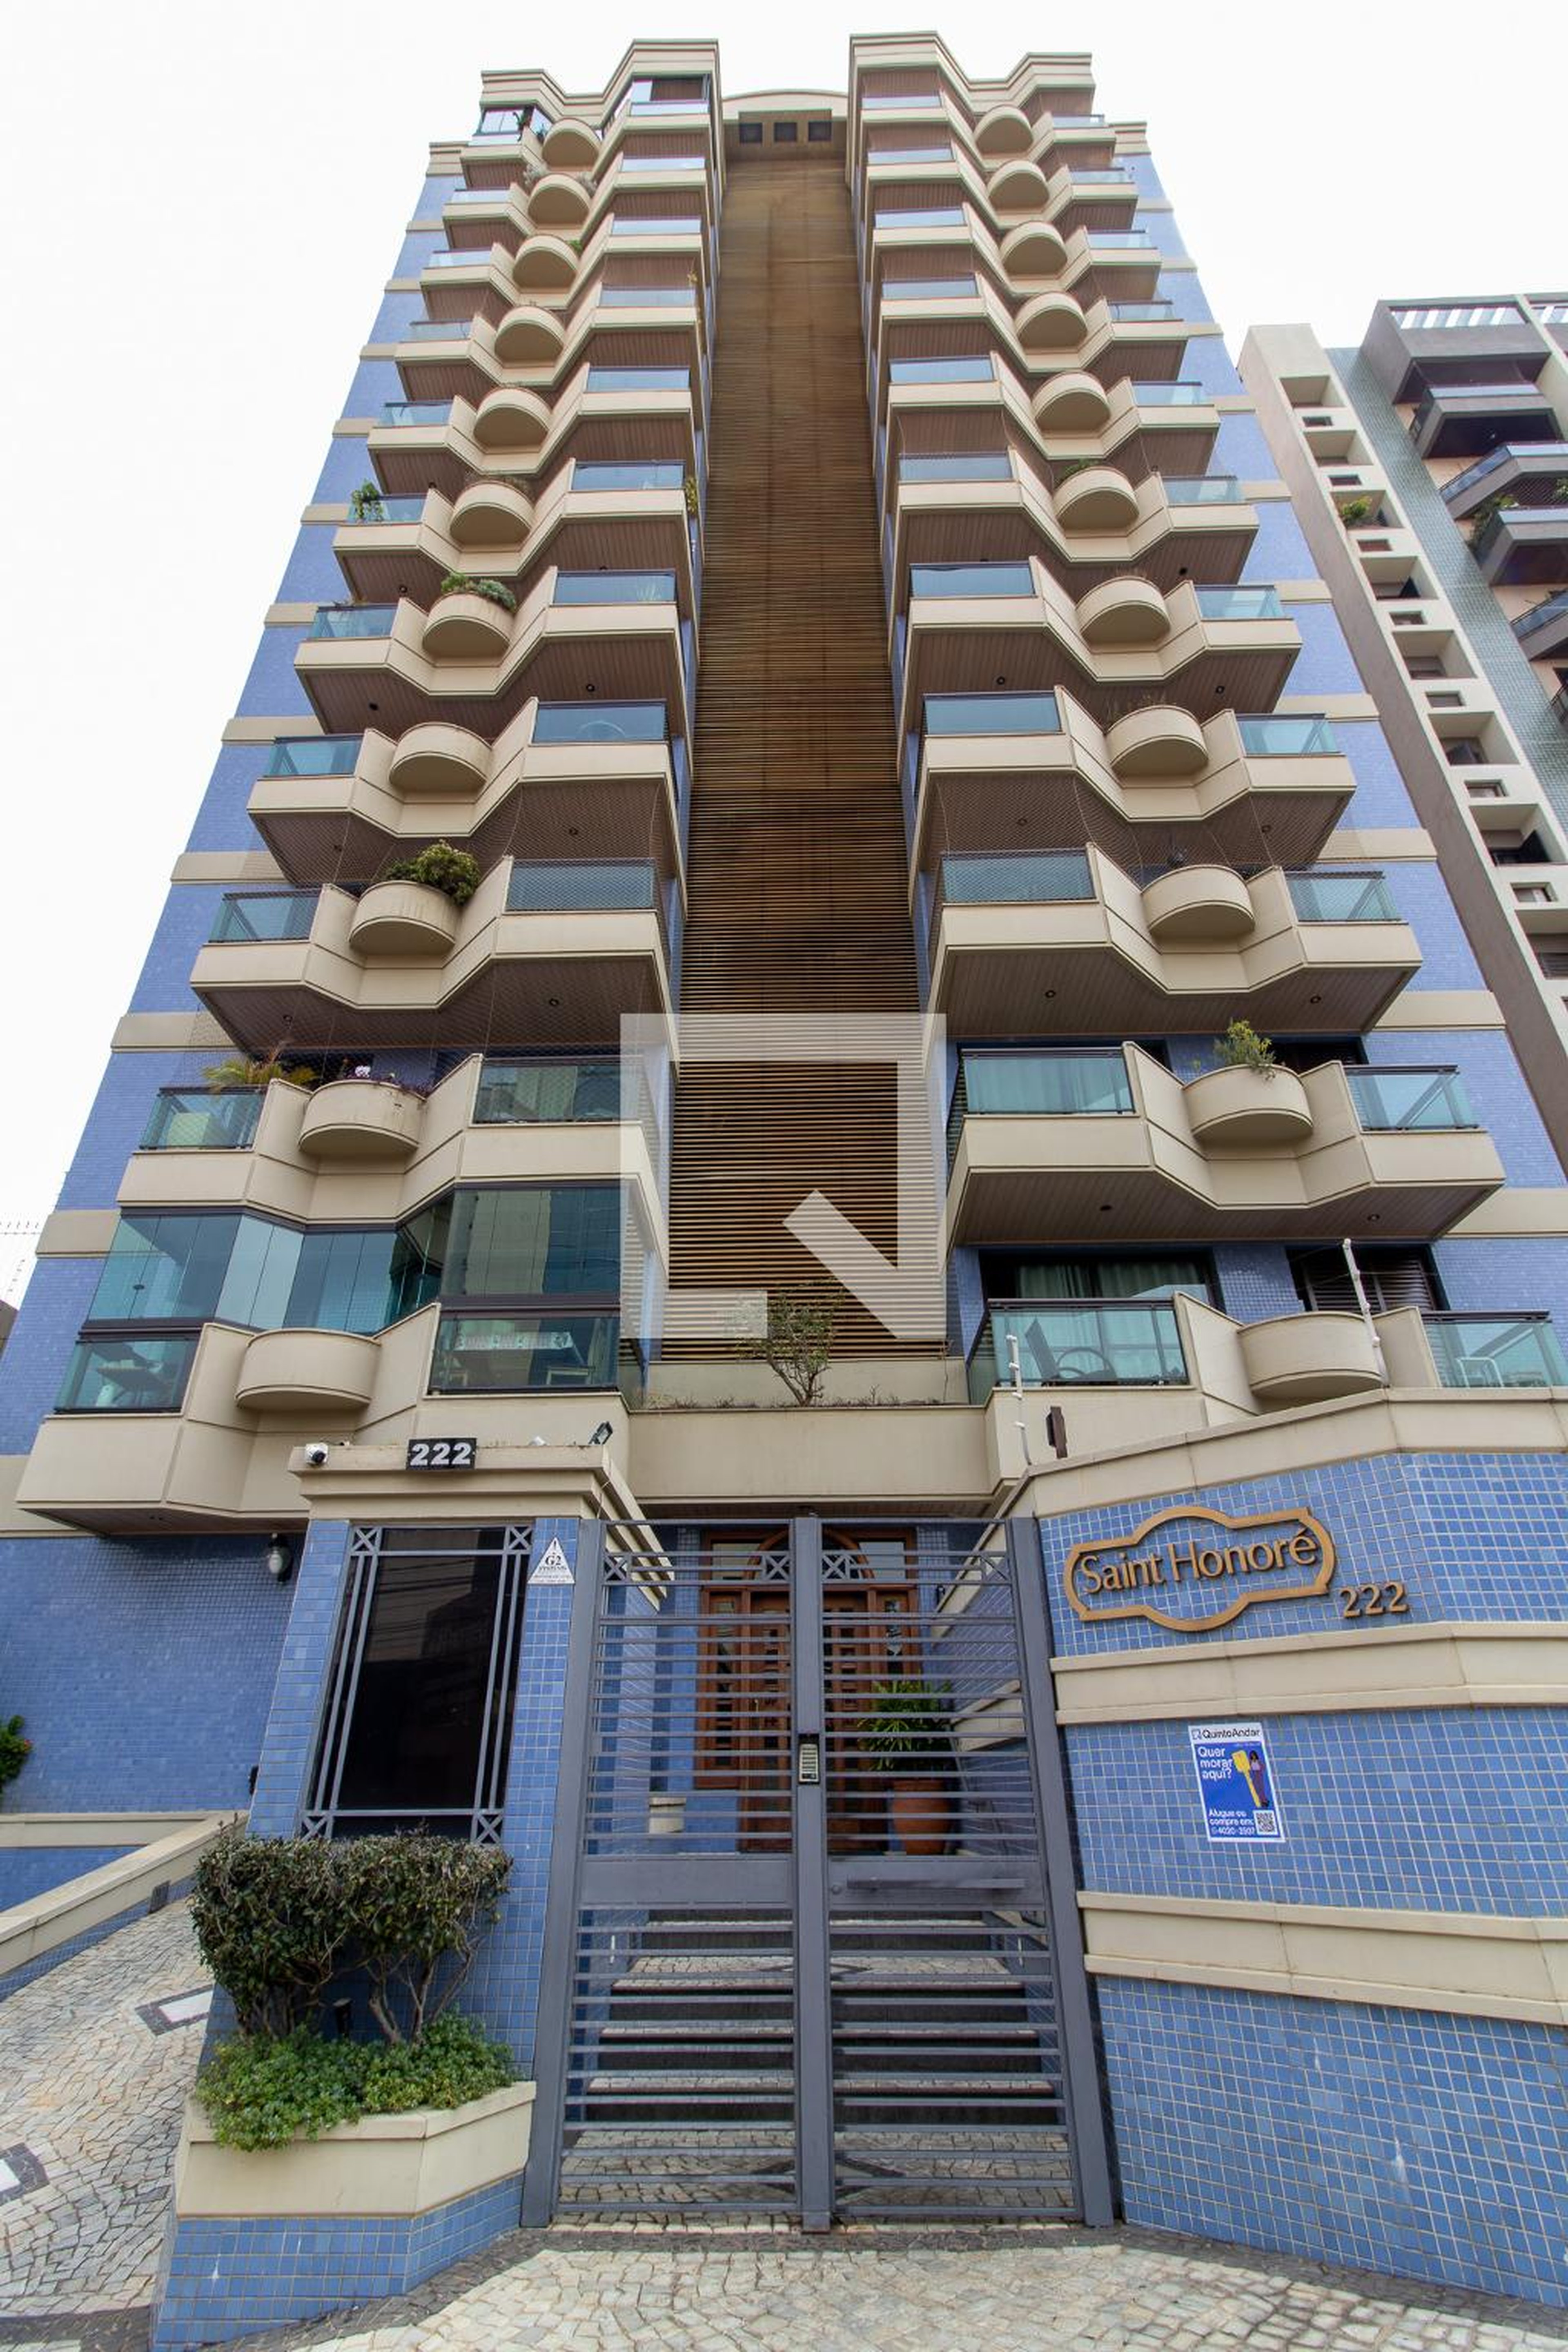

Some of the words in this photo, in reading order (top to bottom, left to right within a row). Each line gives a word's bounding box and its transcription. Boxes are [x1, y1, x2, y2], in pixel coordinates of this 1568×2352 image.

[410, 1442, 472, 1466] 222
[545, 1555, 561, 1566] G2
[1079, 1552, 1166, 1594] Saint
[1168, 1526, 1318, 1582] Honoré
[1339, 1581, 1410, 1618] 222
[1202, 1728, 1260, 1739] QuintoAndar
[1198, 1746, 1225, 1757] Quer
[1200, 1759, 1233, 1768] morar
[1202, 1767, 1232, 1782] aqui?
